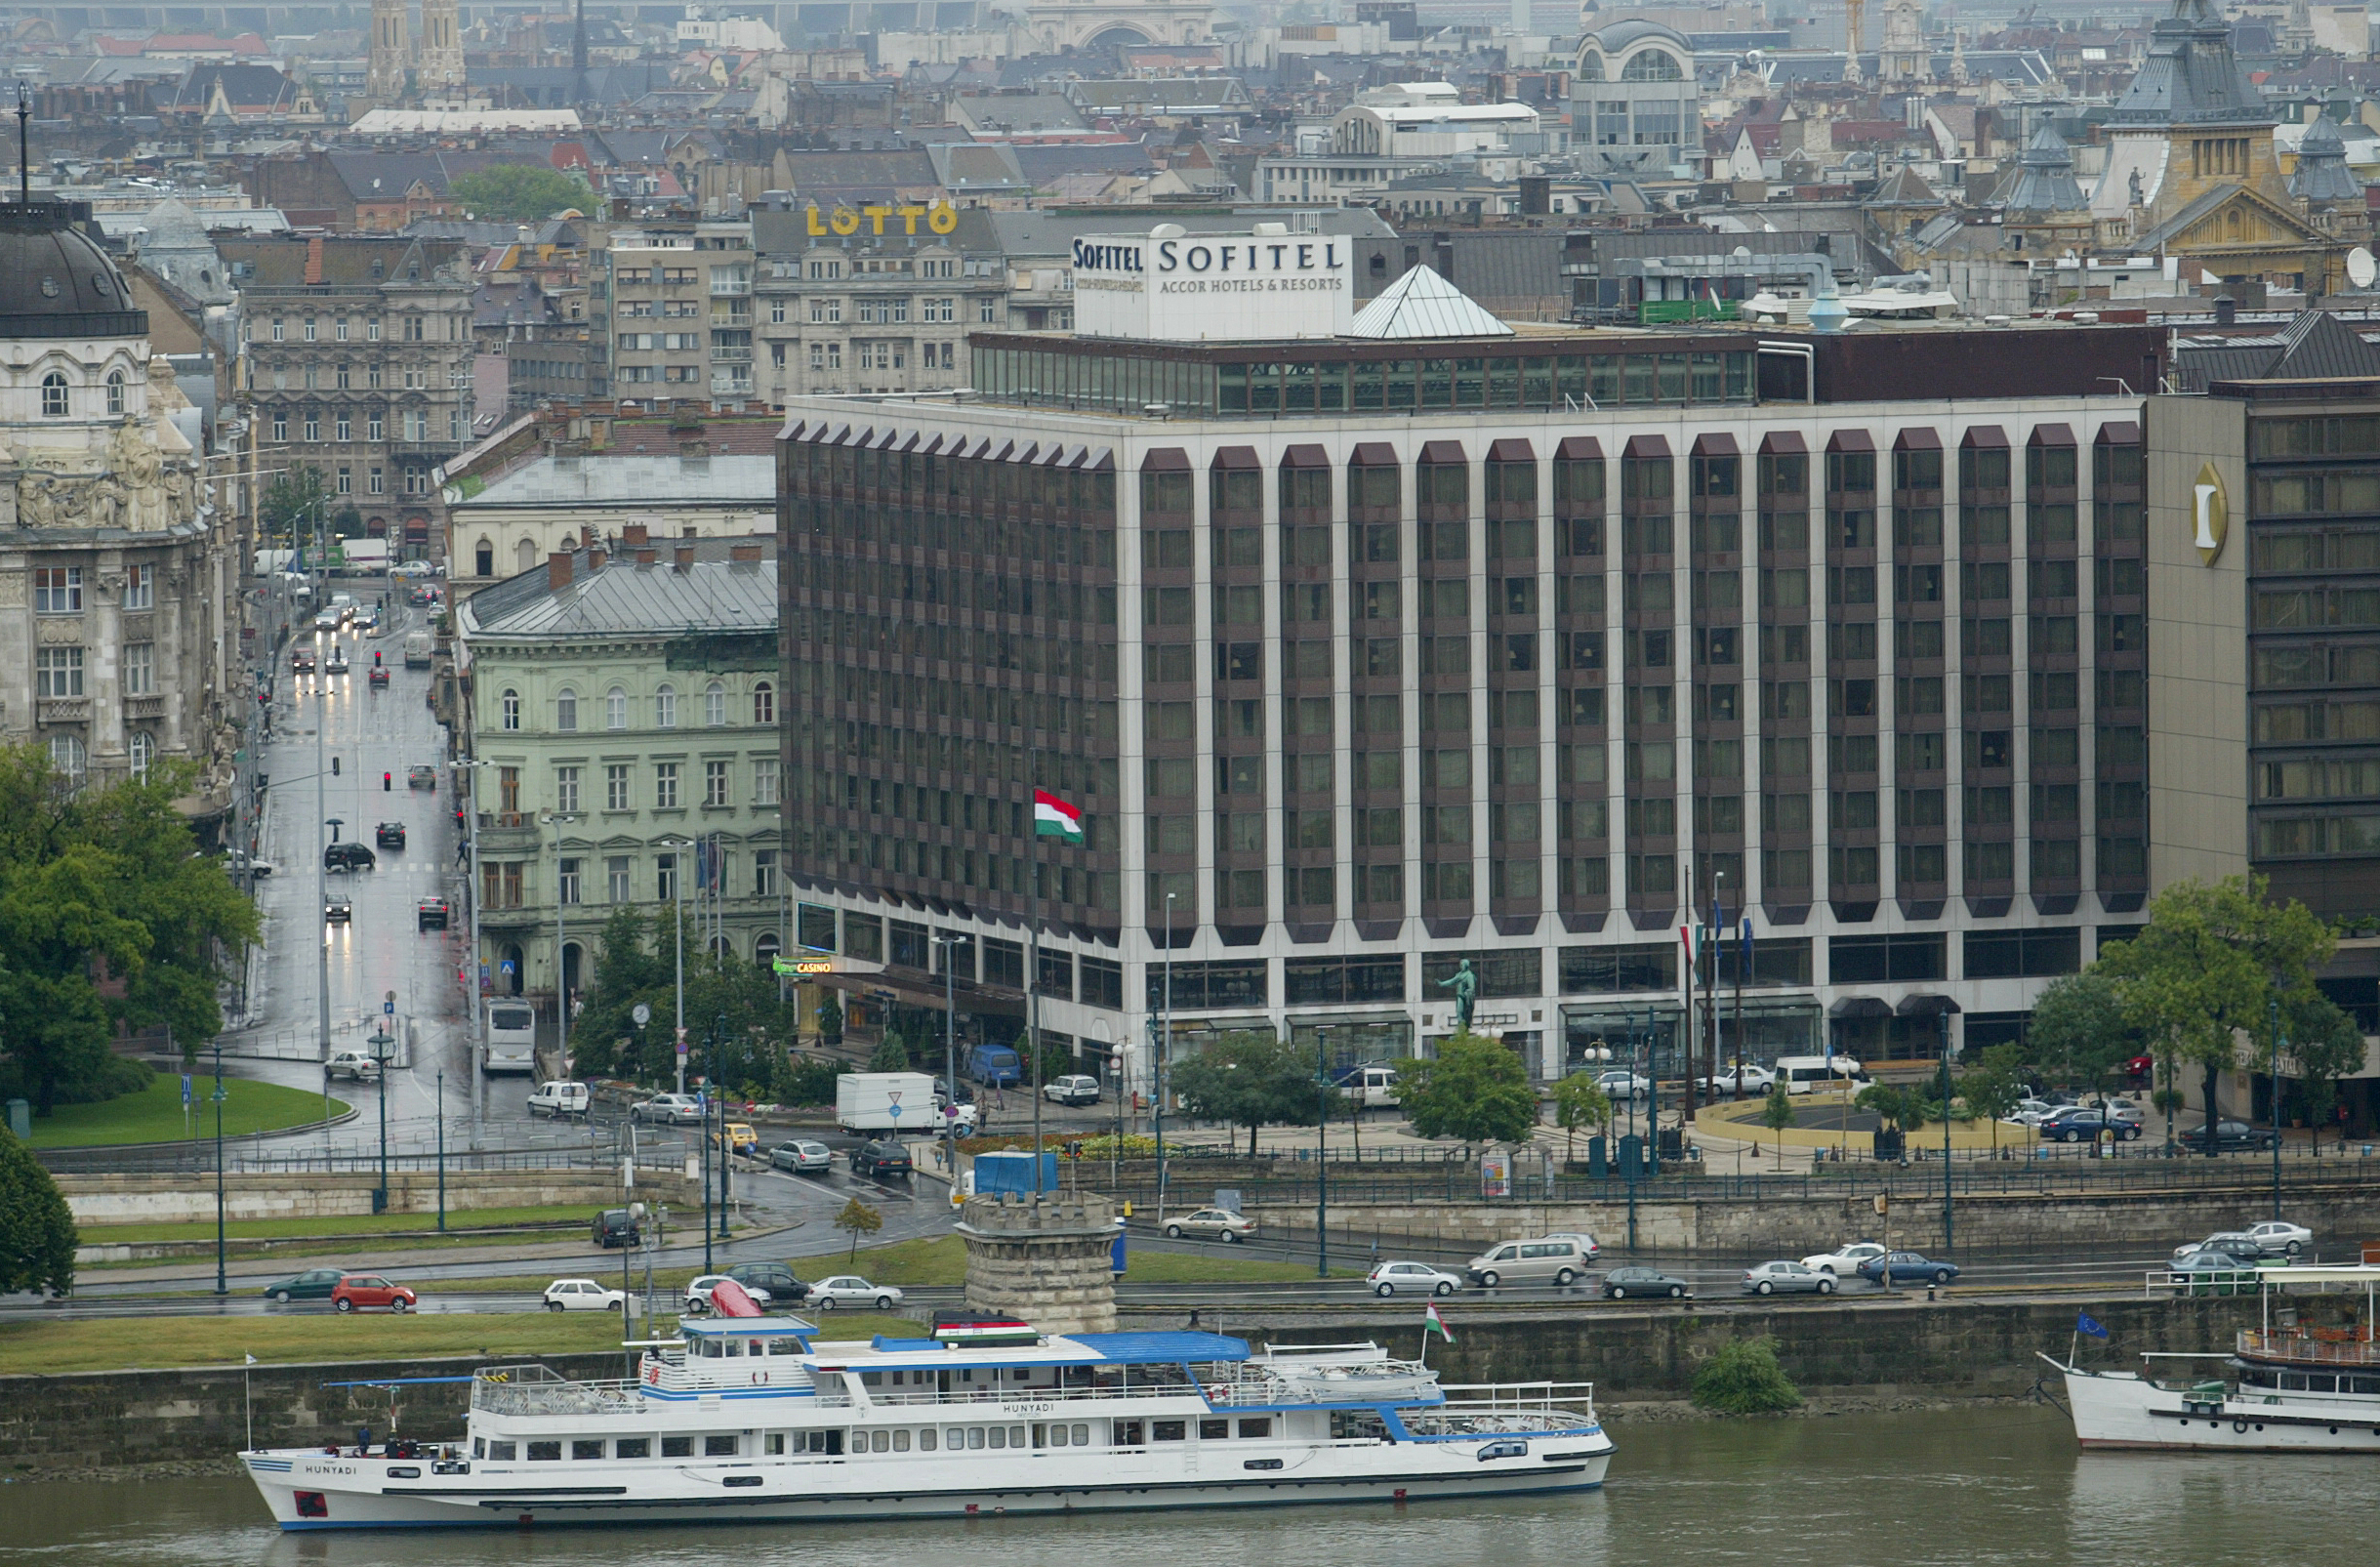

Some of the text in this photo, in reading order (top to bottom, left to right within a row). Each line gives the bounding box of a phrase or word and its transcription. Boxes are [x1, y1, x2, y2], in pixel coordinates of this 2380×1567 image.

[1074, 238, 1143, 271] SOFITEL
[1159, 240, 1343, 272] SOFITEL
[1160, 277, 1342, 293] ACCOR HOTELS & RESORTS
[797, 963, 831, 972] CASINO
[1004, 1403, 1054, 1413] HUNYADI
[306, 1465, 356, 1475] HUNYADI
